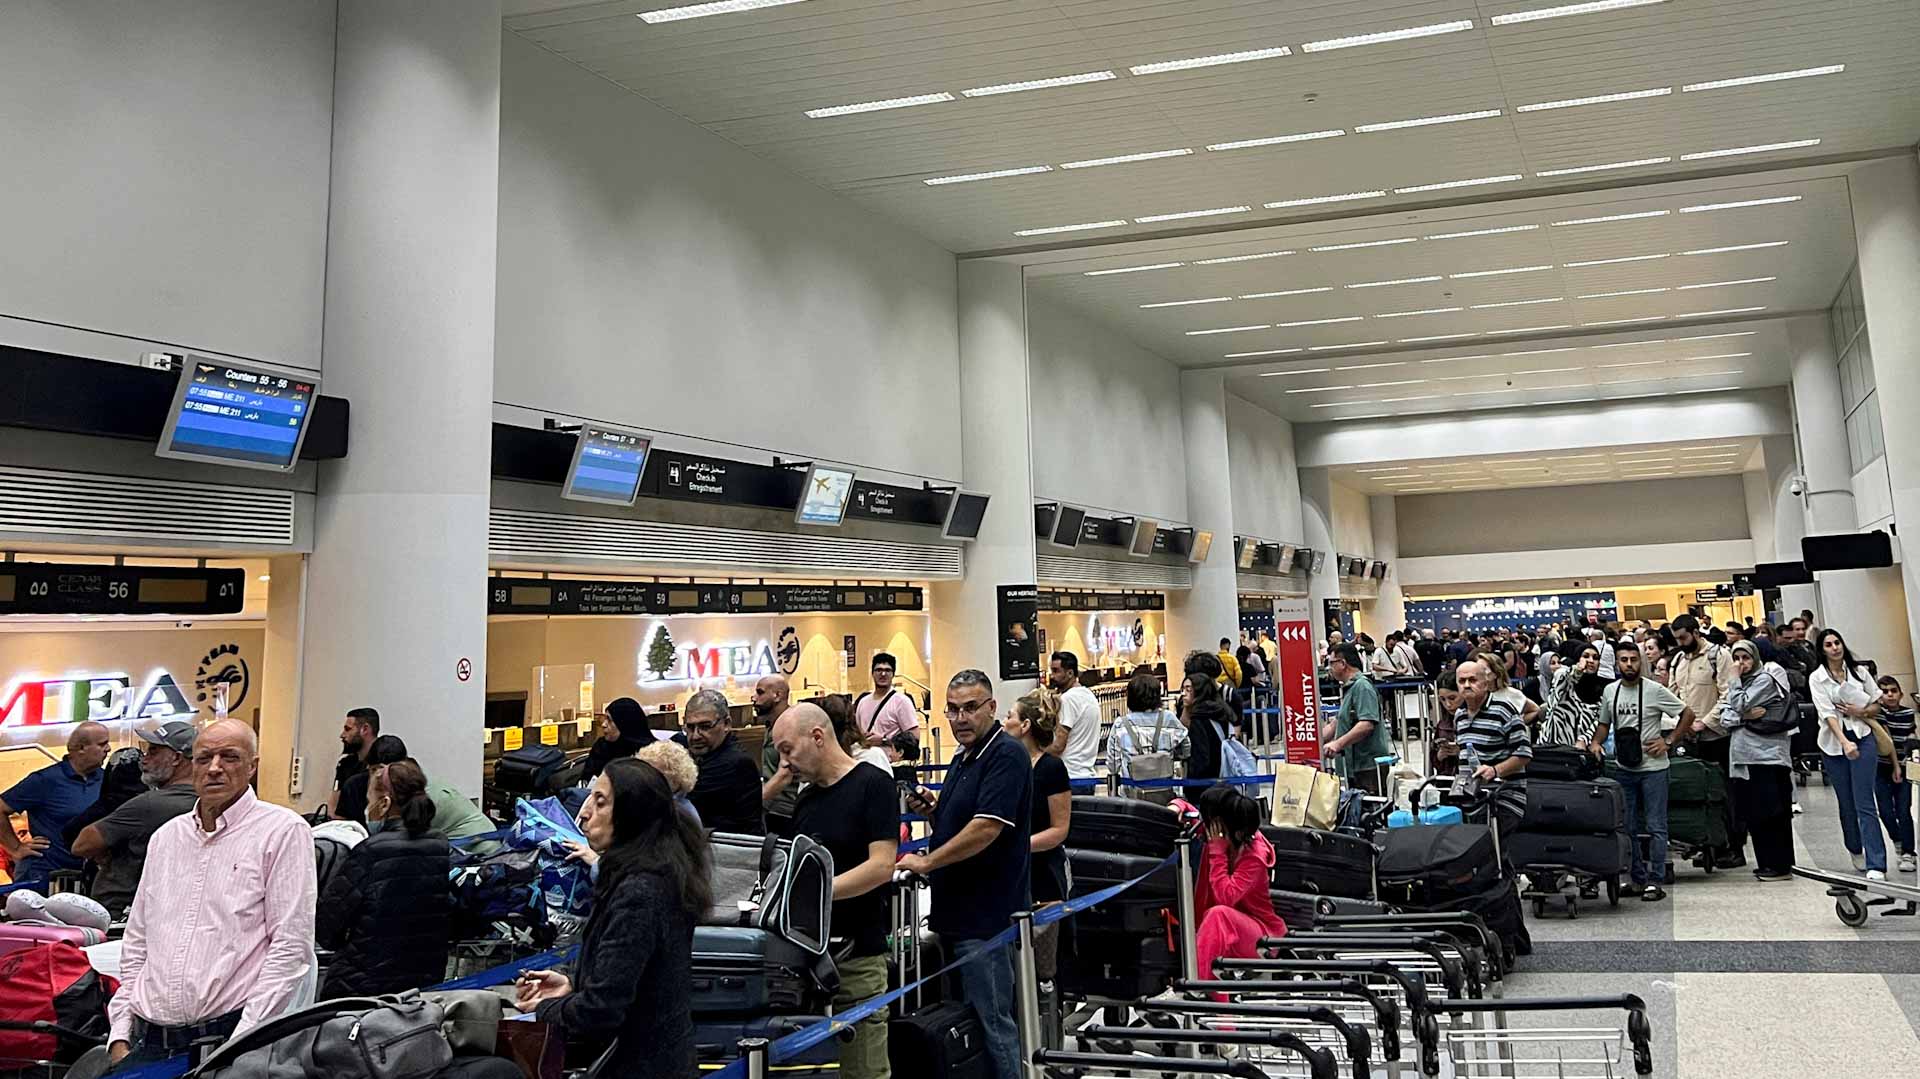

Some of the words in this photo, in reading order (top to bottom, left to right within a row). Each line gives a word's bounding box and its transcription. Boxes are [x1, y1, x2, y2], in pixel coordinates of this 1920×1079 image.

[225, 369, 257, 383] Counters
[260, 375, 269, 385] 55
[219, 406, 231, 416] ME
[230, 407, 241, 417] 211
[108, 582, 129, 598] 56
[494, 589, 506, 602] 58
[656, 592, 666, 605] 59
[731, 594, 740, 605] 60
[686, 645, 780, 678] MEA
[1302, 673, 1316, 741] PRIORITY
[1294, 712, 1306, 741] SKY
